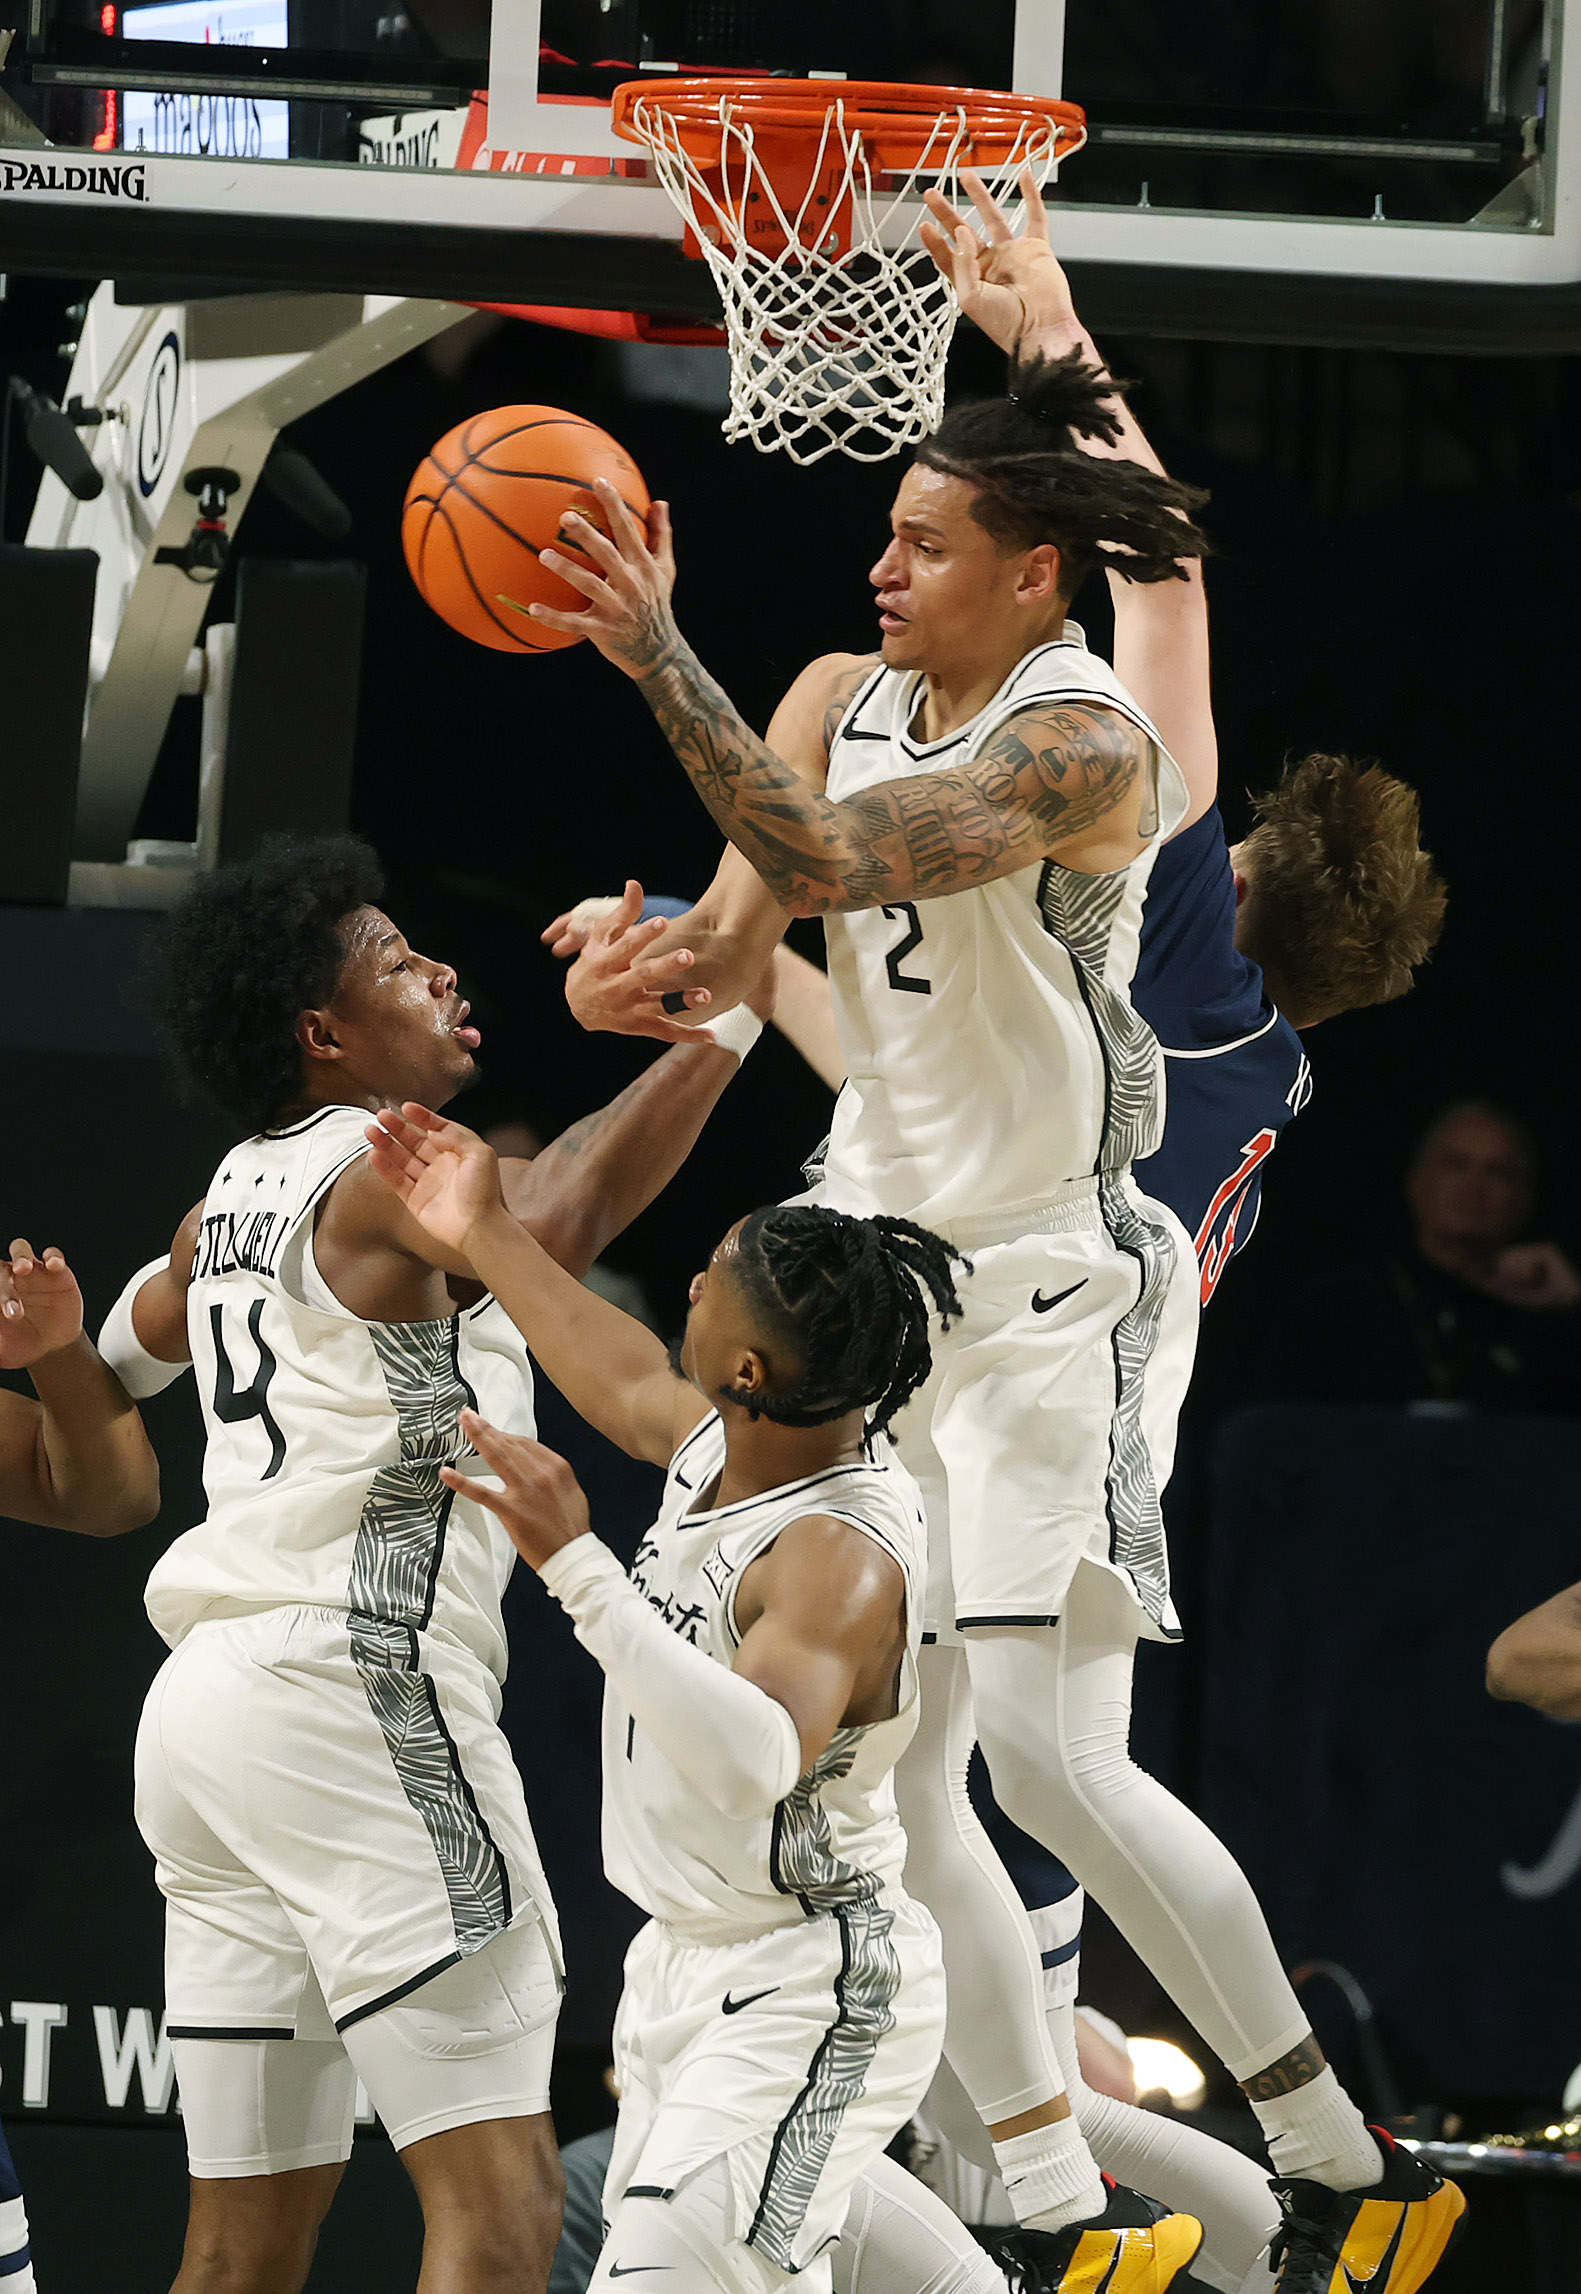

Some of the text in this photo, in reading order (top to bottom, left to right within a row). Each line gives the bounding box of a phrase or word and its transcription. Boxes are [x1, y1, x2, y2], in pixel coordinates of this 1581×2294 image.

[0, 158, 145, 201] PALDING
[880, 901, 931, 994] 2
[209, 1298, 286, 1481] 4
